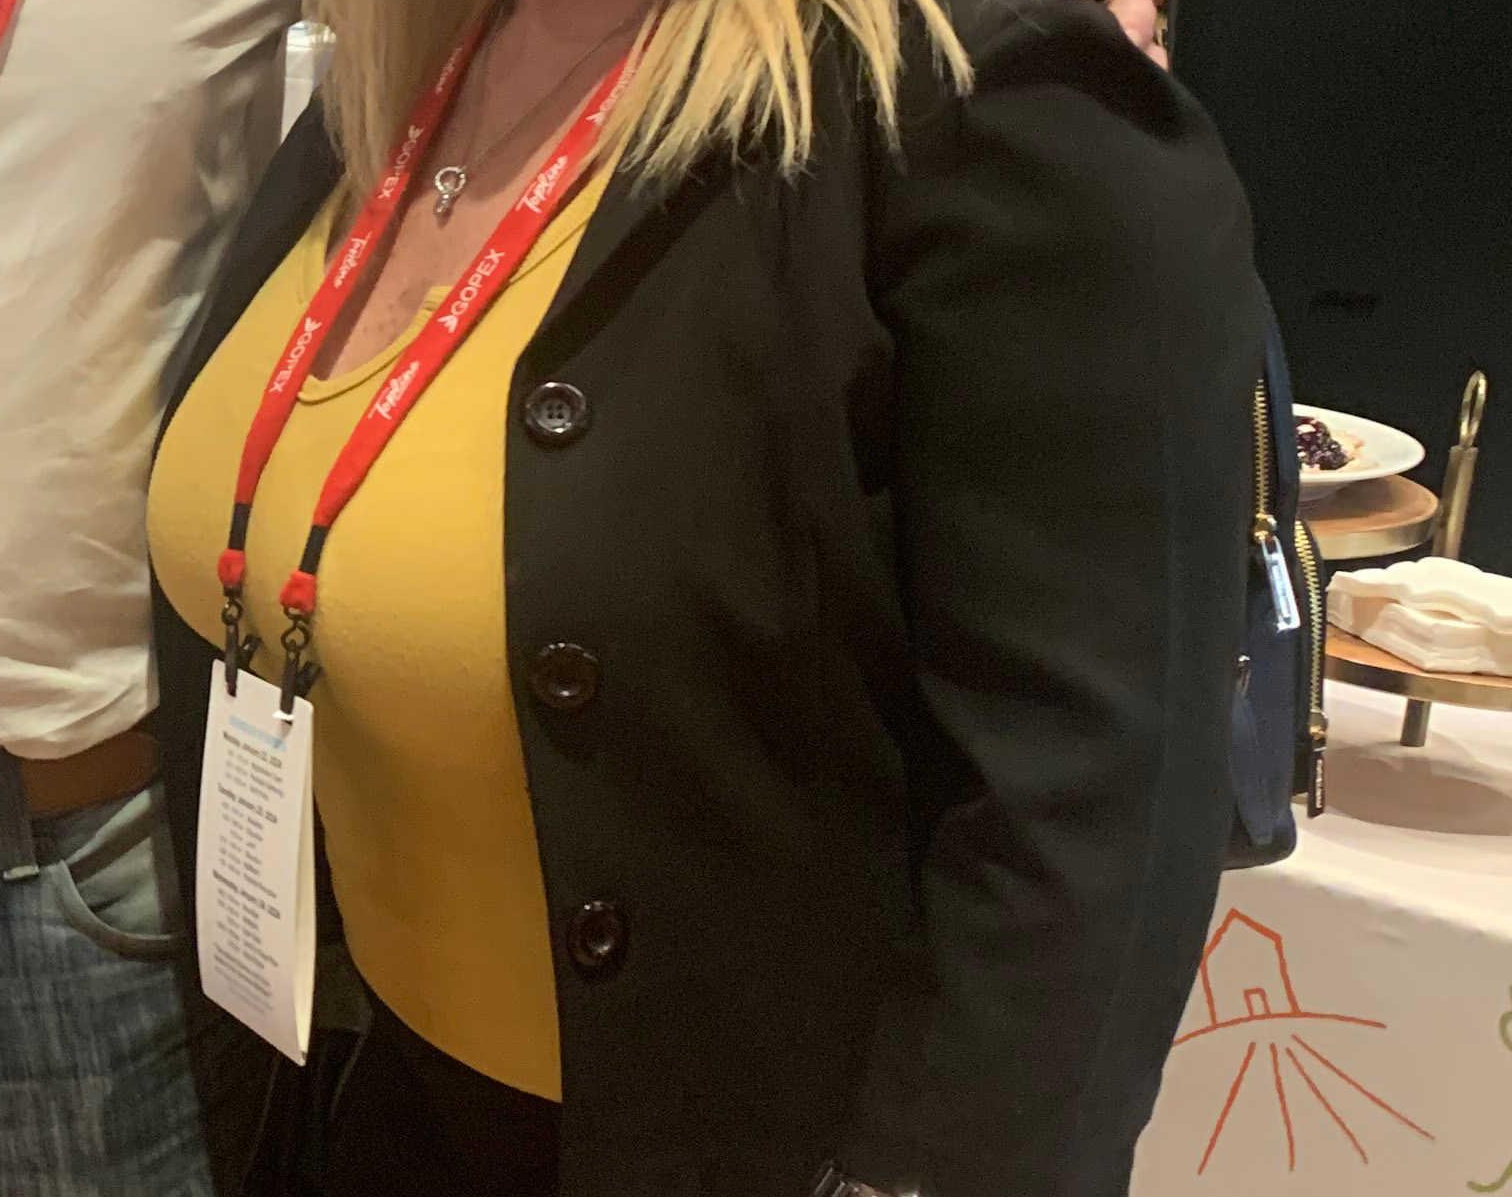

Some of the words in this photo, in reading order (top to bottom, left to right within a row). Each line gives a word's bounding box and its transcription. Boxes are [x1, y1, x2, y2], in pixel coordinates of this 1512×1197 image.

[515, 155, 568, 213] Topline
[451, 248, 506, 316] GOPEX
[367, 360, 420, 420] Topline
